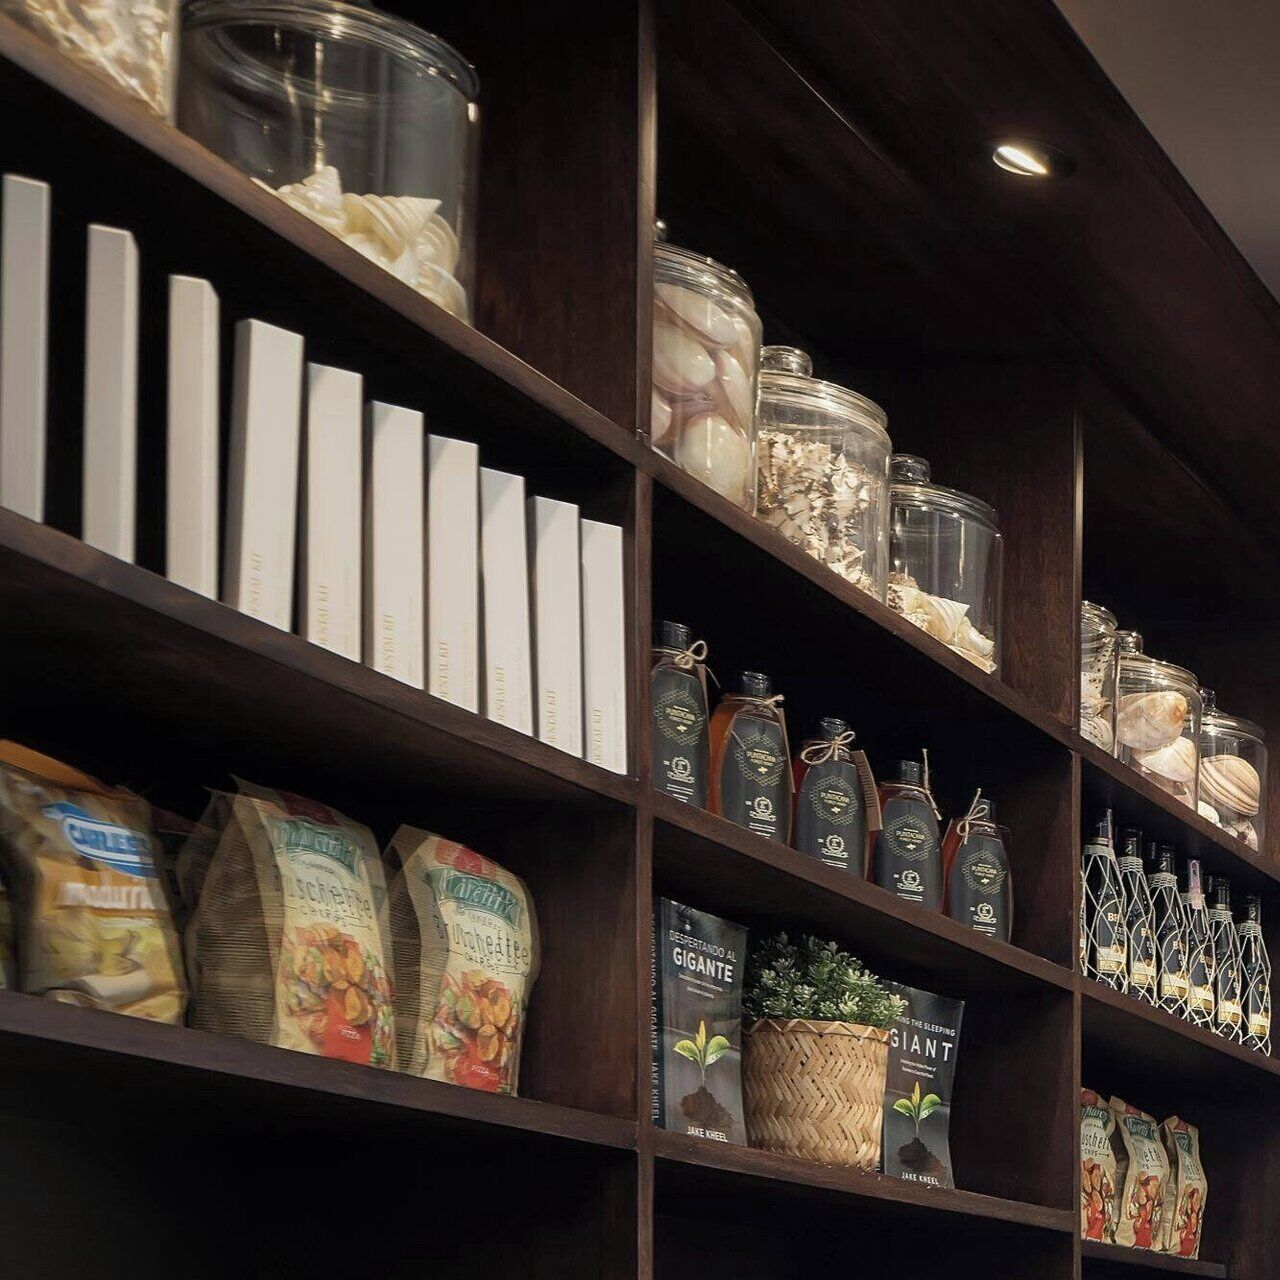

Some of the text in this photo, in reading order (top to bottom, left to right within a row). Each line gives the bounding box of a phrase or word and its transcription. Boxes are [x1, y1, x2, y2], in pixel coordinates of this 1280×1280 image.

[673, 947, 734, 983] GIGANTE
[890, 1027, 953, 1062] GIANT
[911, 1018, 923, 1029] THE
[924, 1022, 956, 1037] SLEEPING
